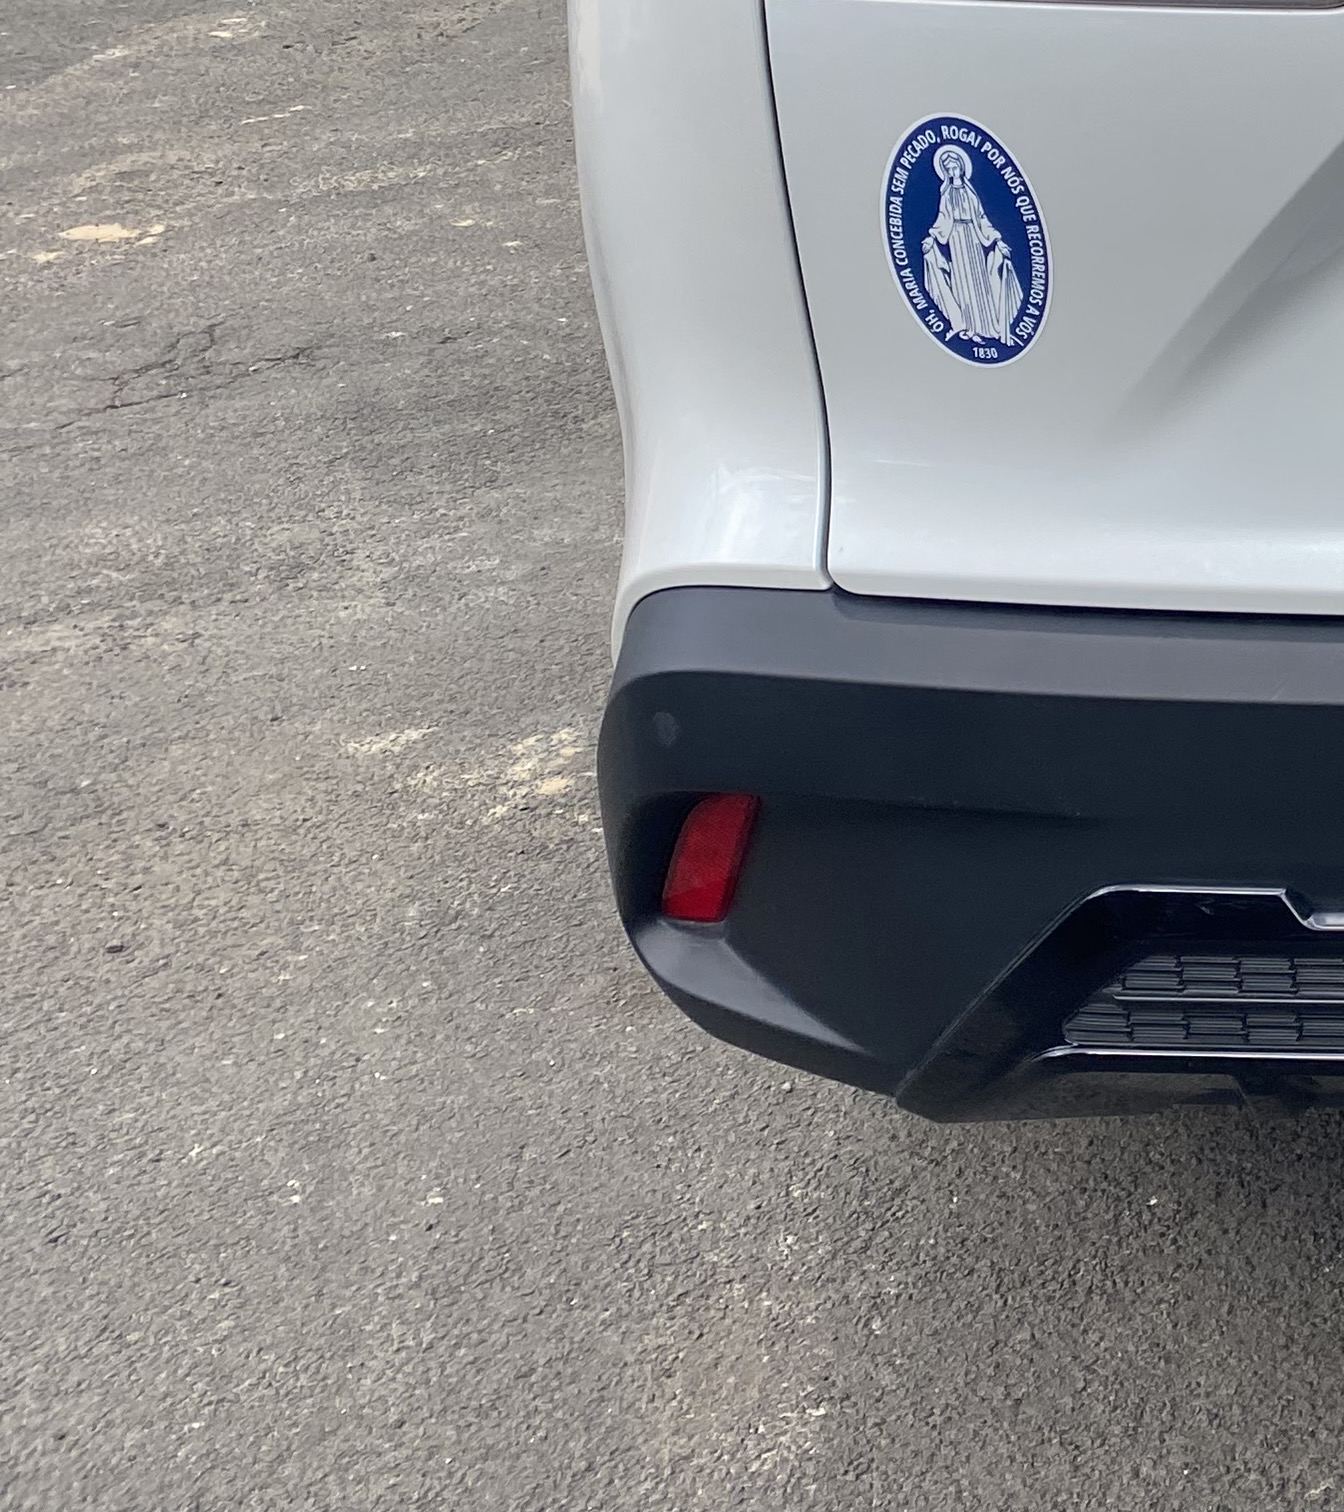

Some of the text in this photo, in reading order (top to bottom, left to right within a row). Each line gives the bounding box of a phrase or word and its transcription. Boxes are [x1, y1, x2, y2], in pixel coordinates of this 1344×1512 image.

[900, 129, 940, 169] PECADO,
[940, 125, 982, 148] ROGAI
[980, 141, 1006, 169] POR
[891, 167, 909, 195] SEM
[1000, 166, 1025, 194] NÓS
[1015, 196, 1037, 222] QUE
[889, 196, 908, 265] CONCEBIDA
[1025, 224, 1046, 306] RECORREMOS
[900, 268, 928, 310] MARIA
[1025, 304, 1040, 316] A
[1015, 316, 1037, 339] VÓS
[972, 347, 998, 359] 1830
